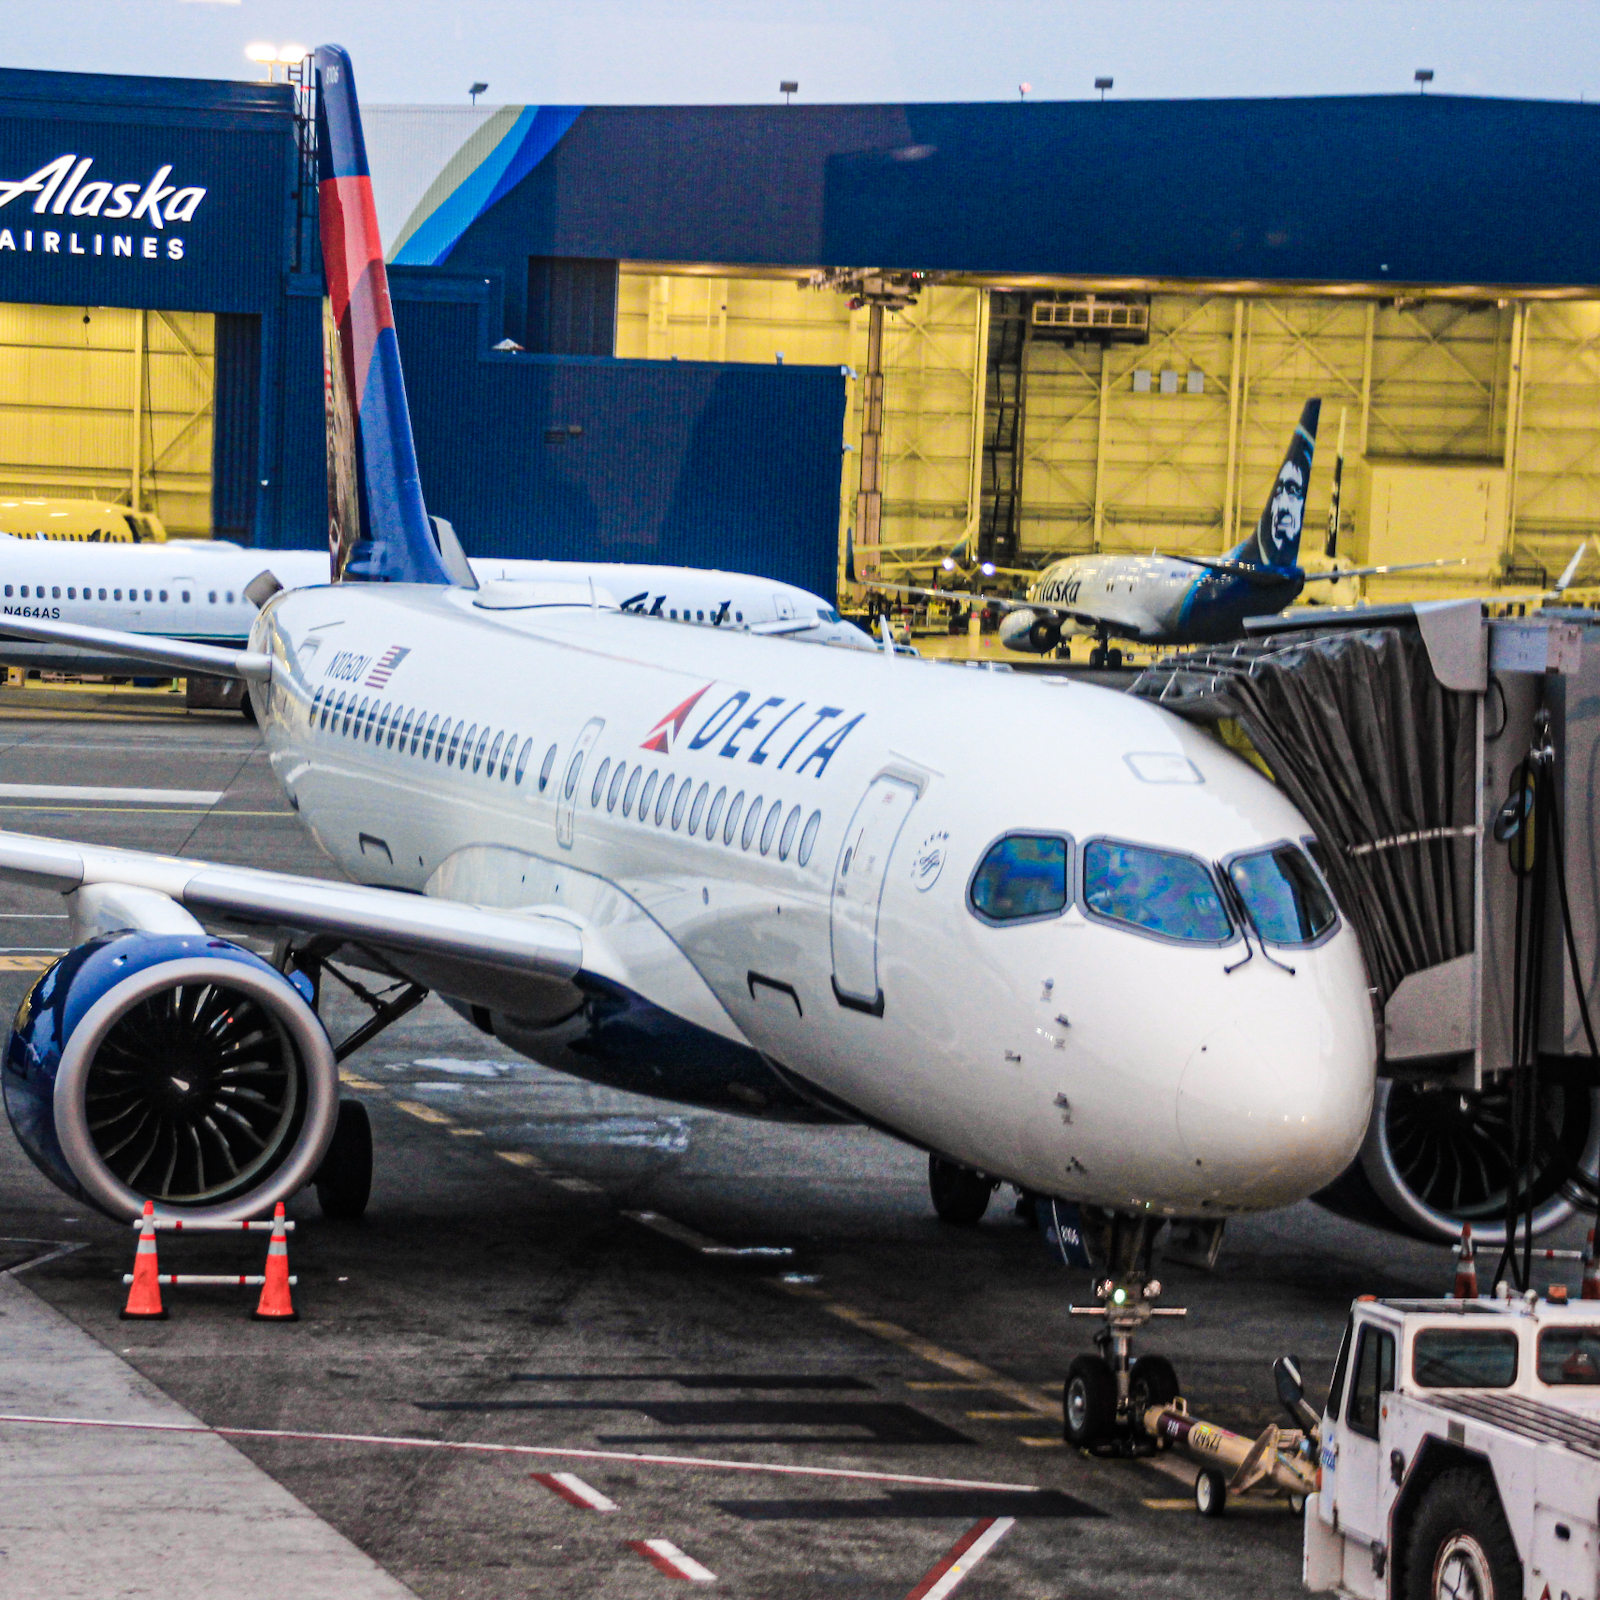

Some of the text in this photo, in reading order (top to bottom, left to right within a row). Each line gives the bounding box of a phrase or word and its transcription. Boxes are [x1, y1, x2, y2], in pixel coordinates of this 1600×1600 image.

[0, 154, 207, 229] Alaska
[0, 229, 185, 260] AIRLINES
[3, 605, 60, 619] N464AS
[324, 650, 373, 683] N106DU
[687, 690, 867, 779] DELTA
